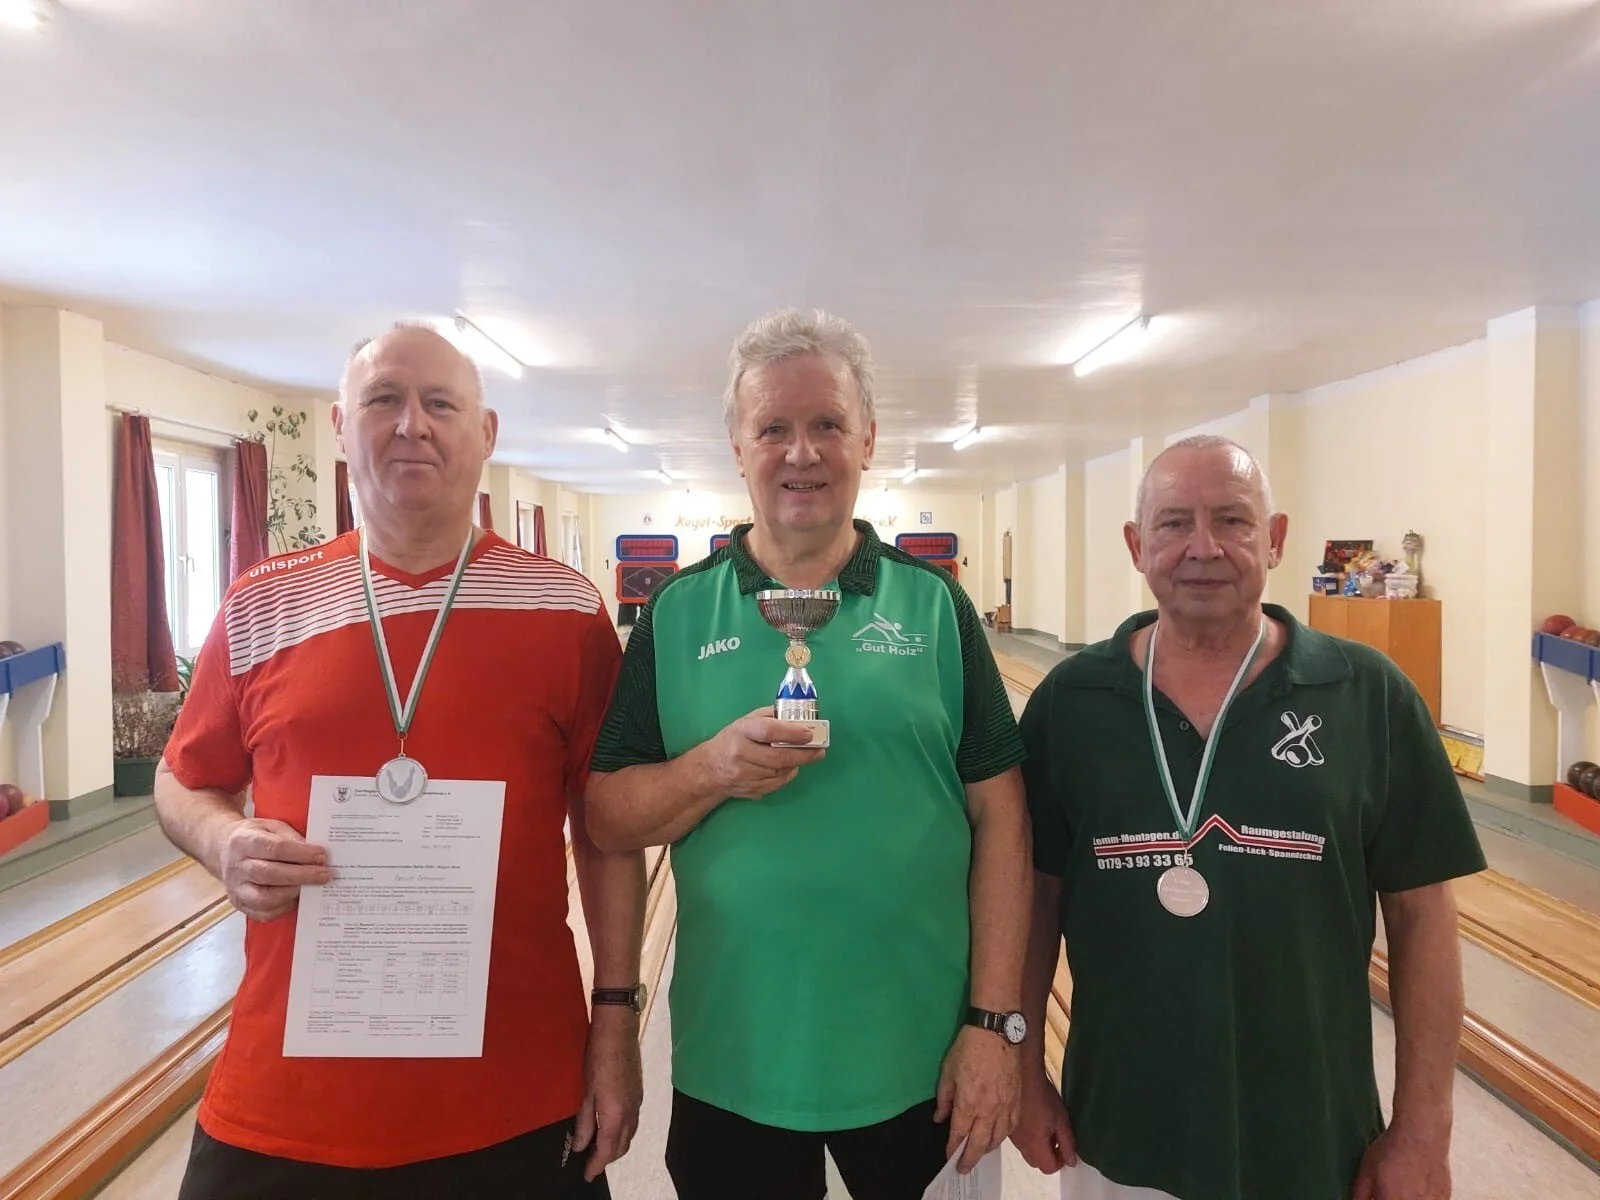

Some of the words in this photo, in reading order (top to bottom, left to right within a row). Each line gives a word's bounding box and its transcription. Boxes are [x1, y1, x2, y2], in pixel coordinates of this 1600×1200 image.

[249, 551, 324, 578] uhlsport
[605, 559, 609, 570] 1
[962, 556, 968, 567] 4
[697, 636, 741, 660] JAKO
[1093, 830, 1182, 846] Lemm-Montagen.d
[1097, 856, 1134, 870] 0179-3
[1135, 855, 1151, 868] 93
[1152, 854, 1172, 867] 33
